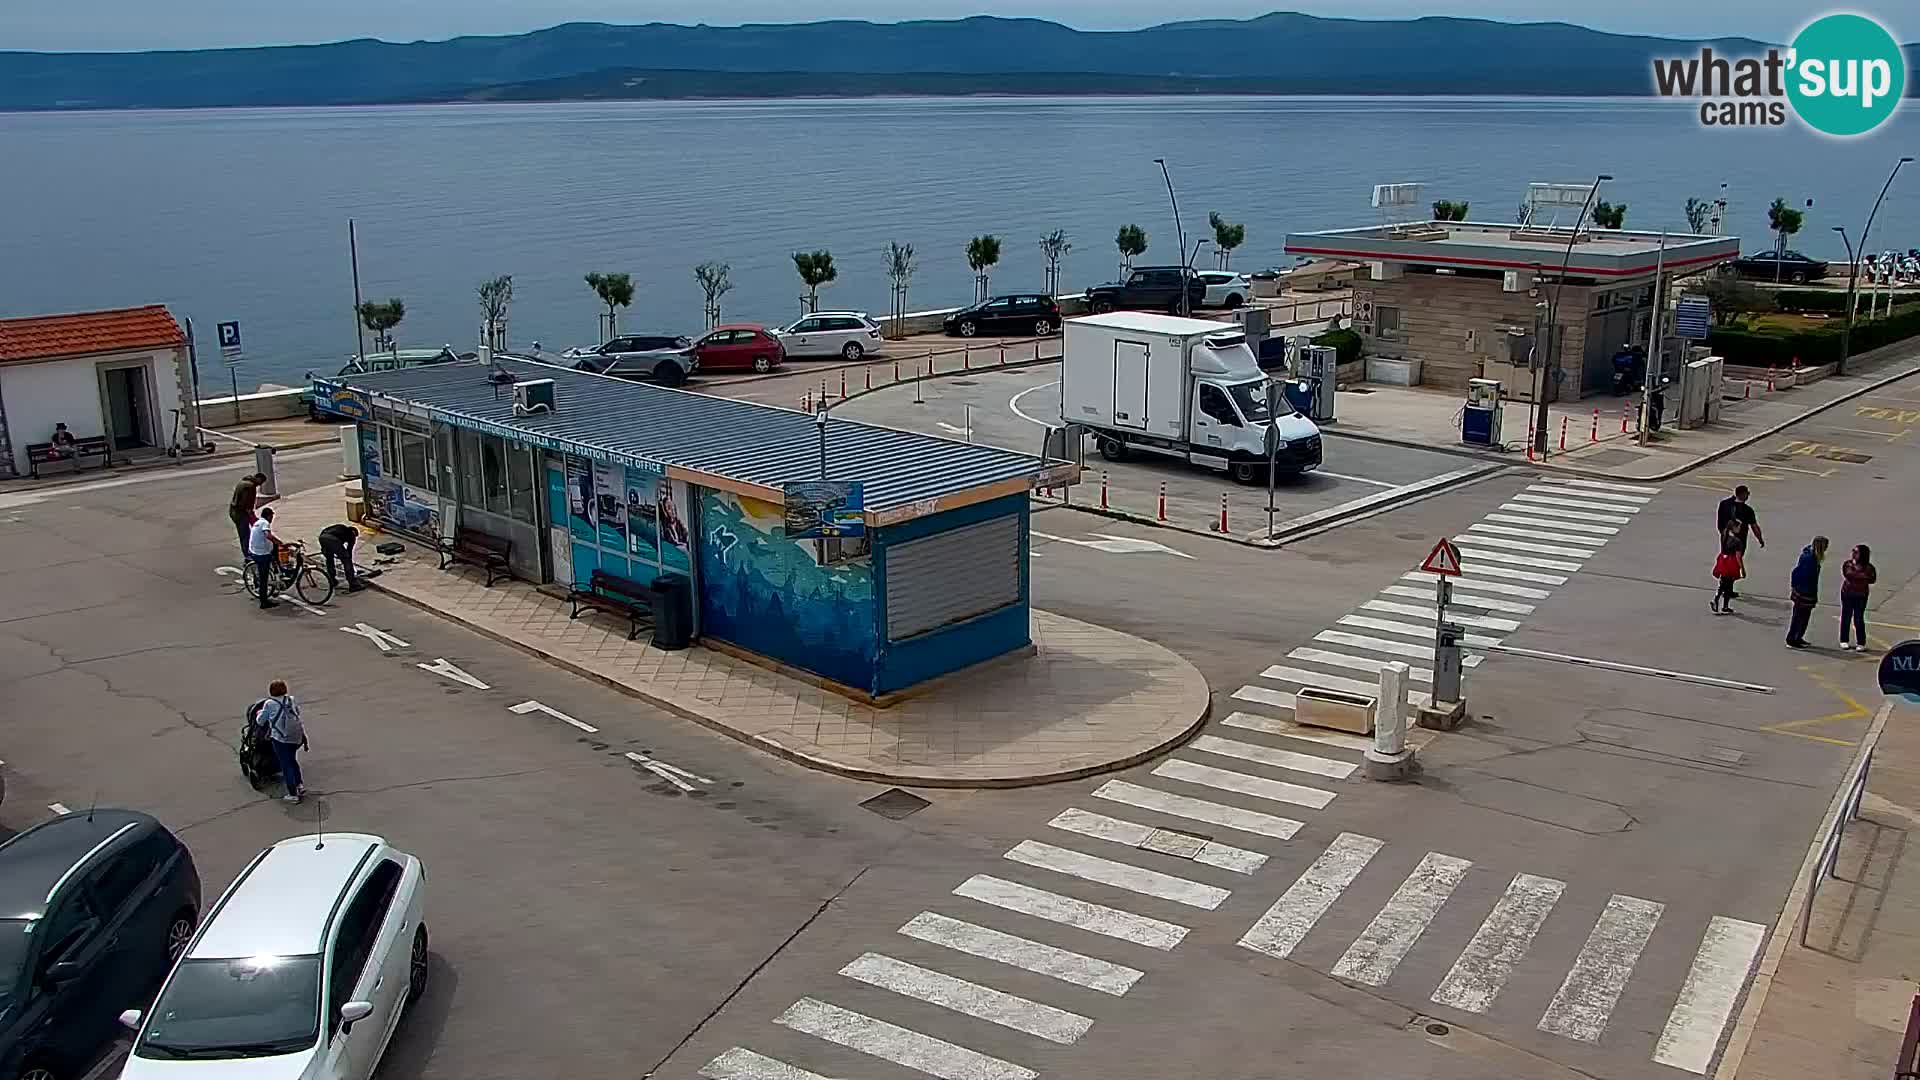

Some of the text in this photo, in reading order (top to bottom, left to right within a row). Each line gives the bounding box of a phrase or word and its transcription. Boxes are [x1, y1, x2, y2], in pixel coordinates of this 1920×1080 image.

[223, 325, 234, 343] P
[519, 431, 550, 447] POSTAJA
[560, 441, 574, 452] BUS
[575, 445, 607, 461] STATION
[608, 453, 634, 467] TICKET
[635, 459, 662, 473] OFFICE
